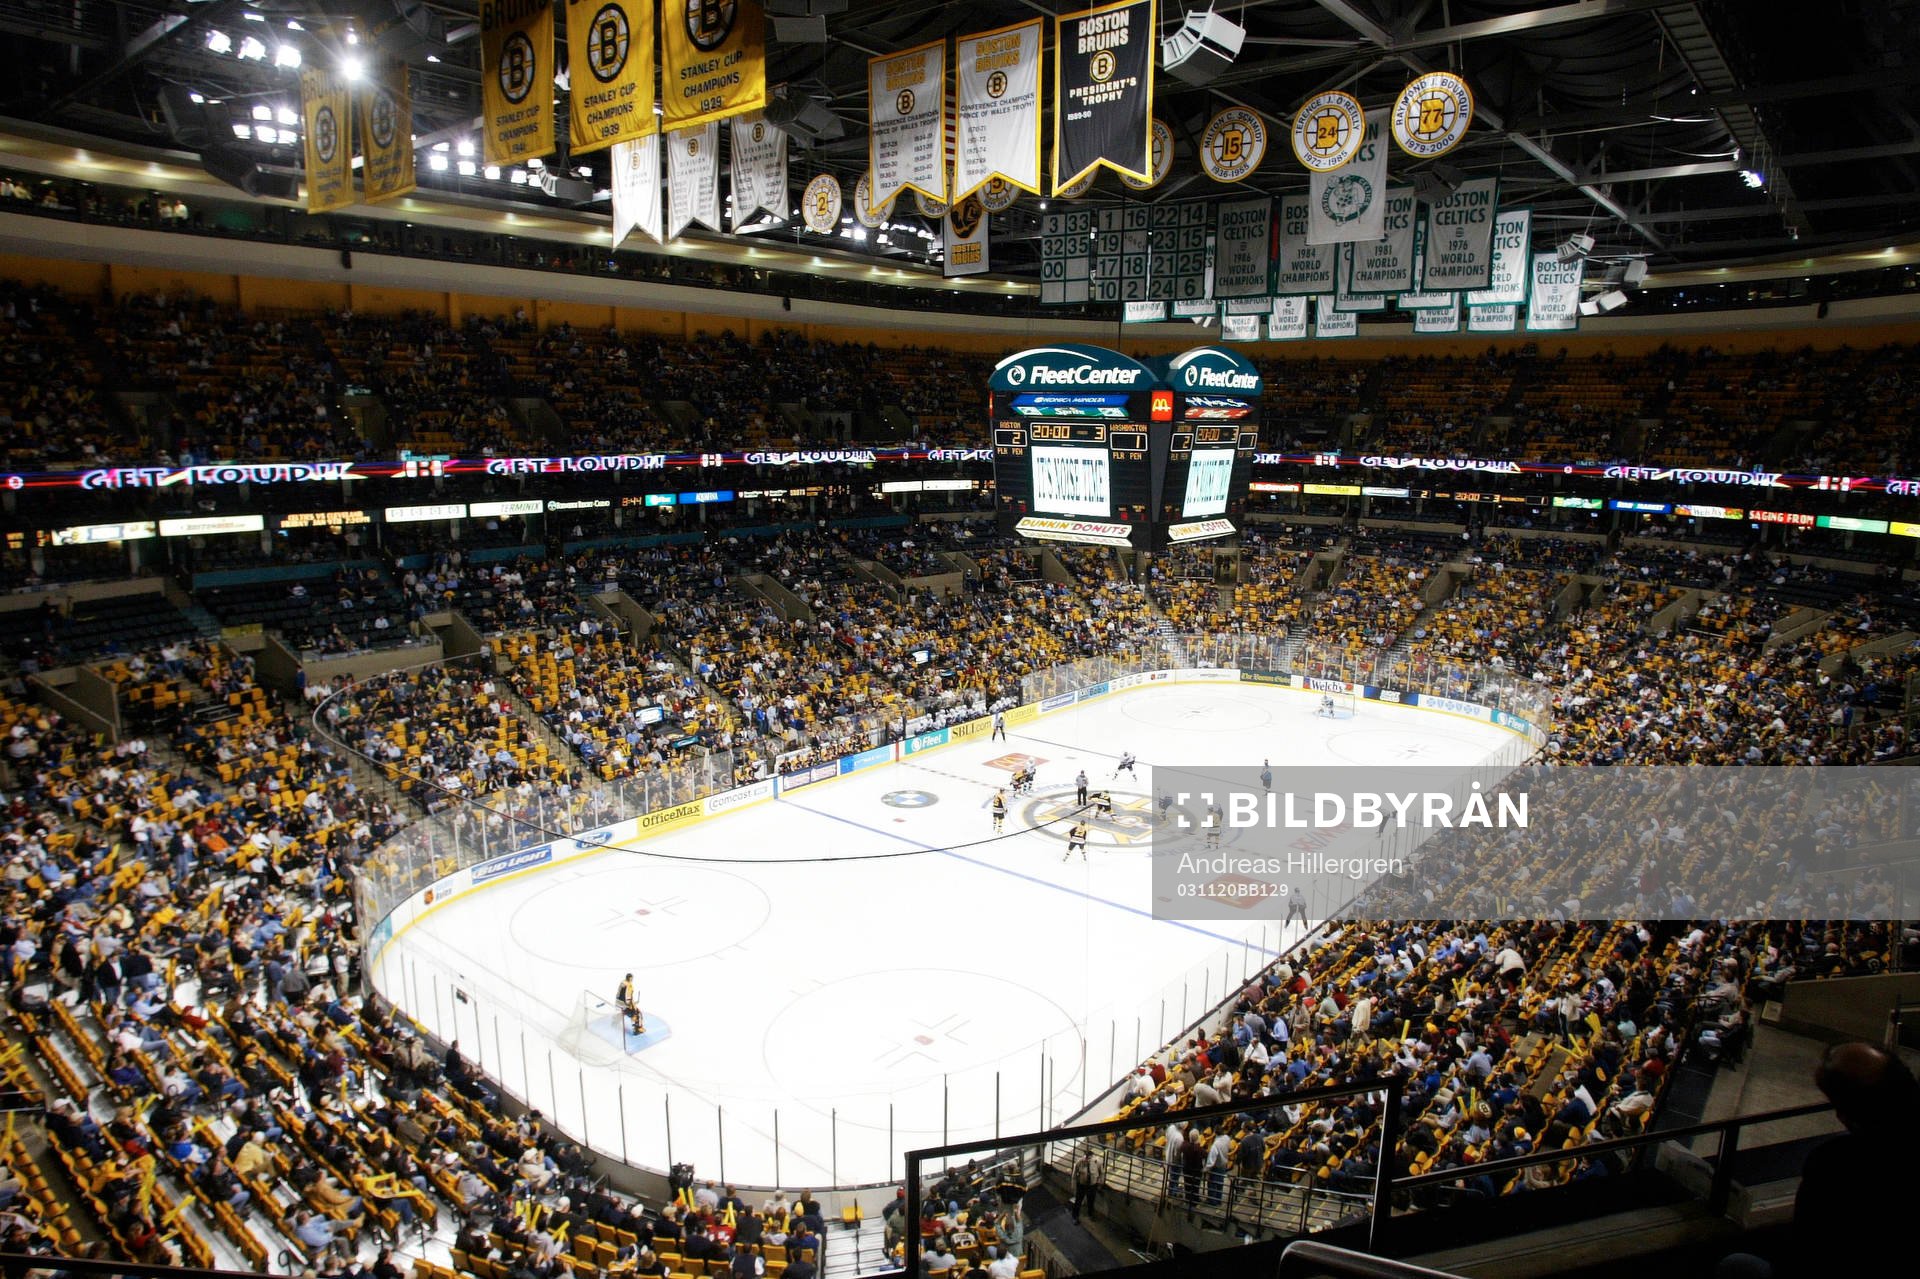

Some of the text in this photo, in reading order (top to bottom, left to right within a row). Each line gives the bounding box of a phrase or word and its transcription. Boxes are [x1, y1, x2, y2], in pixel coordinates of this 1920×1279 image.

[1078, 9, 1130, 37] BOSTON
[1078, 28, 1129, 54] BRUINS
[680, 51, 743, 81] STANLEY CUP
[684, 71, 740, 98] CHAMPIONS
[1069, 77, 1137, 99] PRESIDENT'S
[584, 82, 636, 109] STANLEY CUP
[960, 92, 1035, 112] CONFERENCE CHAMPIONS
[1082, 90, 1123, 106] TROPHY
[1396, 80, 1427, 126] RAYMOND
[1441, 78, 1468, 119] BOURQUE
[587, 101, 634, 125] CHAMPIONS
[991, 105, 1011, 116] WALES
[1296, 99, 1321, 134] TERENCE
[1336, 97, 1360, 131] O'REILLY
[1421, 108, 1442, 125] 77
[601, 123, 620, 138] 1939
[1204, 117, 1225, 148] MILTON
[1238, 112, 1263, 143] SCHMIDT
[1318, 127, 1336, 139] 24
[1225, 137, 1240, 155] 15
[1404, 133, 1455, 153] 1979-2000
[1385, 197, 1412, 214] TON
[1434, 190, 1490, 209] BOSTON
[1127, 211, 1146, 228] 16
[1154, 207, 1178, 226] 22
[1184, 205, 1204, 225] 14
[1223, 208, 1266, 226] BOSTON
[1286, 205, 1309, 220] BOS
[1435, 208, 1486, 226] CELTICS
[1050, 217, 1058, 234] 3
[1068, 213, 1089, 233] 33
[1105, 214, 1113, 229] 1
[1384, 214, 1409, 231] TICS
[1494, 221, 1524, 235] STON
[1154, 231, 1177, 250] 23
[1181, 228, 1202, 248] 15
[1223, 224, 1264, 241] CELTICS
[1044, 238, 1064, 257] 32
[1067, 236, 1089, 255] 35
[1100, 235, 1119, 252] 19
[1375, 245, 1392, 256] 1981
[1449, 240, 1468, 251] 1976
[1297, 248, 1316, 259] 1984
[1440, 253, 1475, 264] WORLD
[1043, 261, 1064, 279] 00
[1099, 259, 1118, 276] 17
[1124, 256, 1143, 274] 18
[1154, 255, 1175, 274] 21
[1179, 253, 1201, 272] 25
[1228, 264, 1256, 275] WORLD
[1291, 259, 1321, 271] WORLD
[1366, 257, 1398, 269] WORLD
[1536, 261, 1579, 272] BOSTON
[1281, 271, 1330, 283] CHAMPIONS
[1355, 269, 1407, 281] CHAMPIONS
[1428, 265, 1485, 278] CHAMPIONS
[1492, 273, 1512, 283] ORLD
[1537, 273, 1575, 285] CELTICS
[1152, 280, 1174, 298] 24
[1184, 278, 1195, 297] 6
[1218, 274, 1264, 287] CHAMPIONS
[1098, 281, 1117, 299] 10
[1127, 281, 1138, 299] 2
[1480, 306, 1506, 314] WORLD
[1533, 312, 1574, 321] CHAMPIONS
[1540, 304, 1567, 313] WORLD
[1278, 315, 1298, 324] WORLD
[1319, 321, 1354, 330] CHAMPIONS
[1419, 316, 1455, 324] CHAMPIONS
[1471, 314, 1513, 323] CHAMPIONS
[1271, 324, 1305, 332] CHAMPIONS
[1030, 364, 1142, 385] FleetCenter
[1199, 367, 1259, 390] FleetCenter
[1012, 431, 1021, 445] 2
[1032, 425, 1104, 440] 20:00 3
[1182, 436, 1190, 449] 2
[487, 458, 550, 475] GET
[80, 468, 170, 491] GET
[1021, 518, 1129, 535] DUNKIN' DONUTS
[1786, 513, 1815, 525] FROM
[1311, 679, 1343, 692] Welch's
[921, 733, 943, 750] Fleet
[641, 803, 701, 829] OfficeMax
[473, 849, 549, 879] BUD LIGHT
